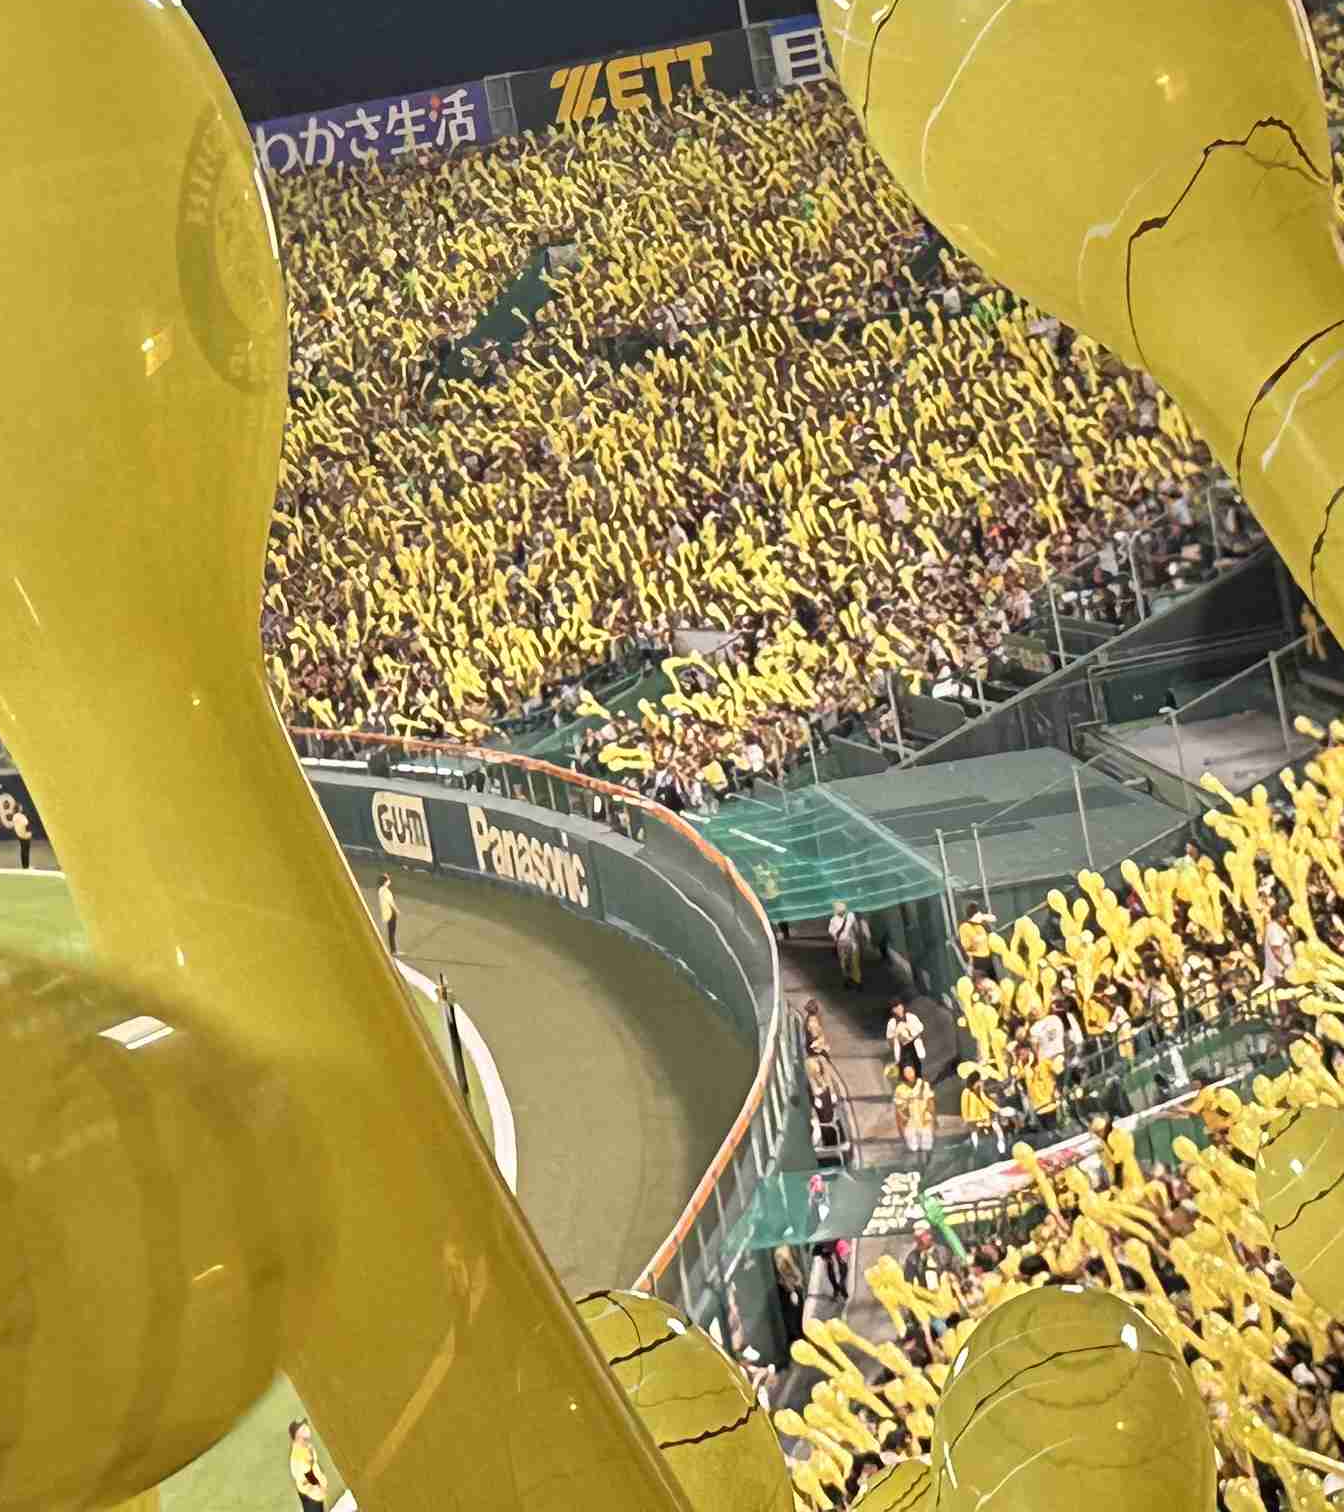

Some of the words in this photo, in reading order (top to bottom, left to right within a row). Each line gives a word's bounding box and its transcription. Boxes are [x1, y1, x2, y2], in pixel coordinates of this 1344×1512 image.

[550, 40, 712, 122] ZETT
[256, 88, 476, 175] わかさ生活
[467, 805, 589, 909] Panasonic
